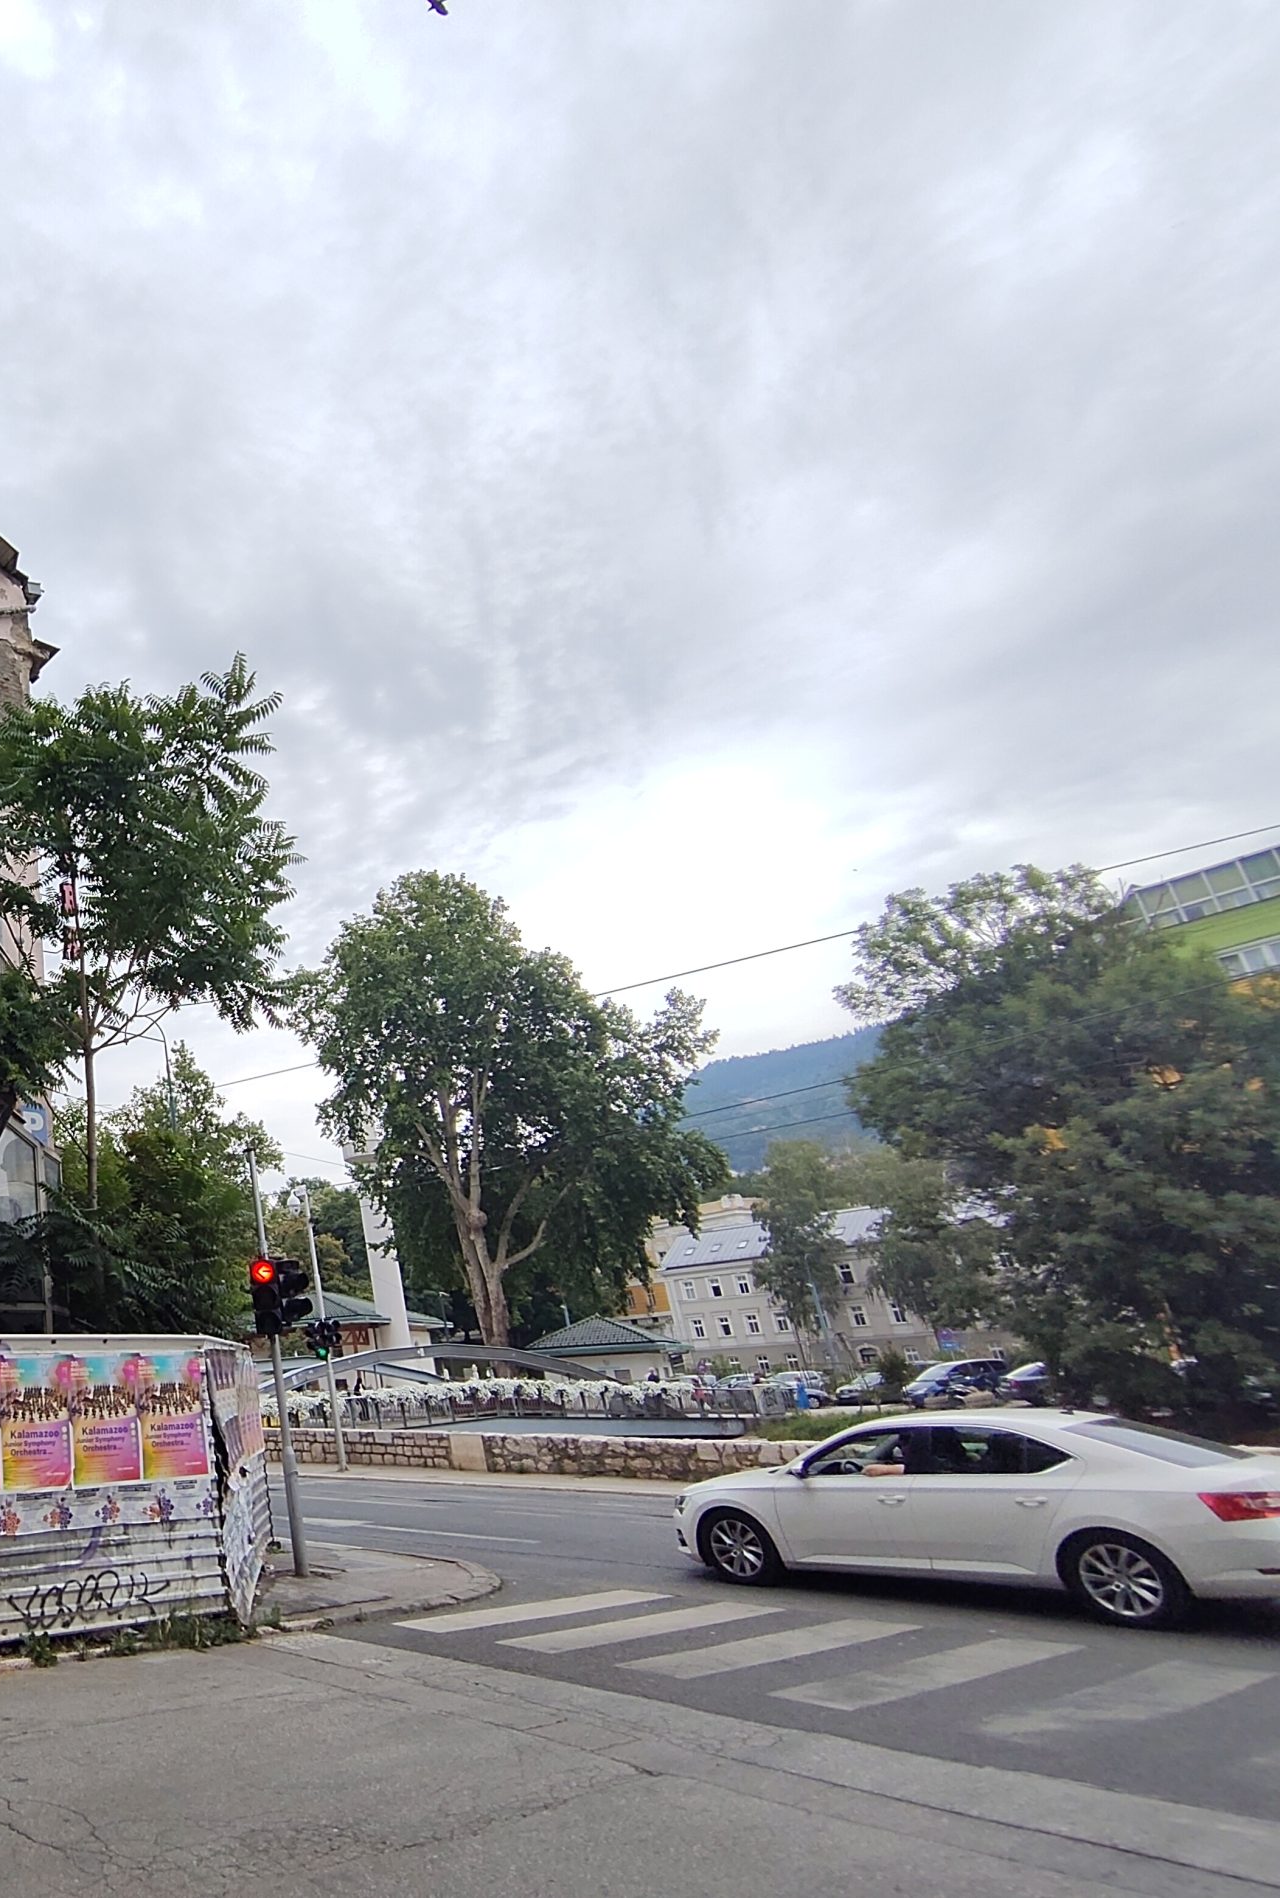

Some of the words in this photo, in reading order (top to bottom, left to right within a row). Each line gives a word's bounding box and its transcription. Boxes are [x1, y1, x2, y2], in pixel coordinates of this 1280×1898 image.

[82, 1426, 129, 1436] Kalamazoo
[150, 1421, 195, 1432] Kalamazoo
[10, 1428, 60, 1439] Kalamazoo
[163, 1431, 192, 1441] Symphony
[3, 1440, 23, 1448] Junior
[24, 1439, 56, 1449] Symphony
[95, 1435, 125, 1445] Symphony
[151, 1439, 185, 1448] Orchestra
[10, 1447, 48, 1457] Orchestra
[82, 1442, 117, 1452] Orchestra
